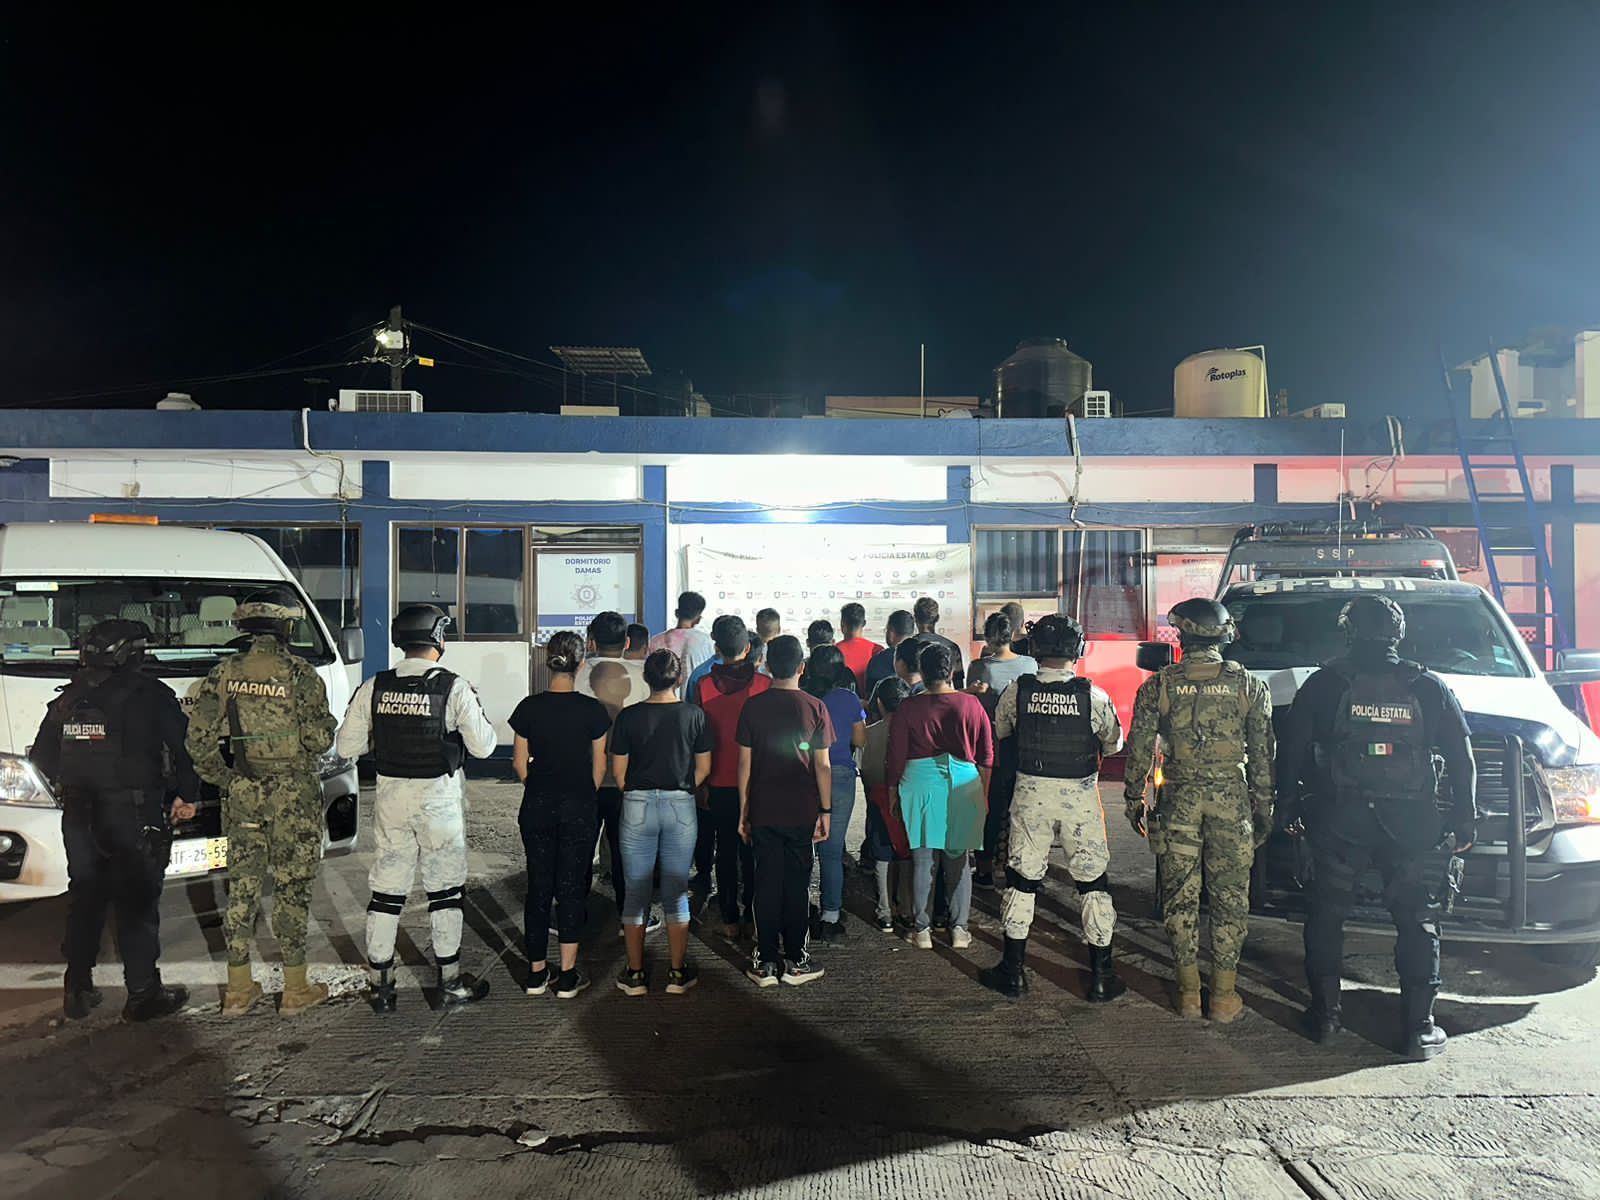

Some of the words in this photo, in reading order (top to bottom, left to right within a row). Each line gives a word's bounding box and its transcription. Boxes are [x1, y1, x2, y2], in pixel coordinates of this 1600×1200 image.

[1210, 368, 1247, 382] Rotoplas
[896, 551, 930, 559] ESTATAL
[227, 681, 286, 698] MARINA
[382, 692, 430, 705] GUARDIA
[1031, 692, 1078, 705] GUARDIA
[377, 703, 432, 716] NACIONAL
[1027, 703, 1080, 716] NACIONAL
[1380, 707, 1411, 719] ESTATAL
[82, 724, 106, 735] ESTATAL
